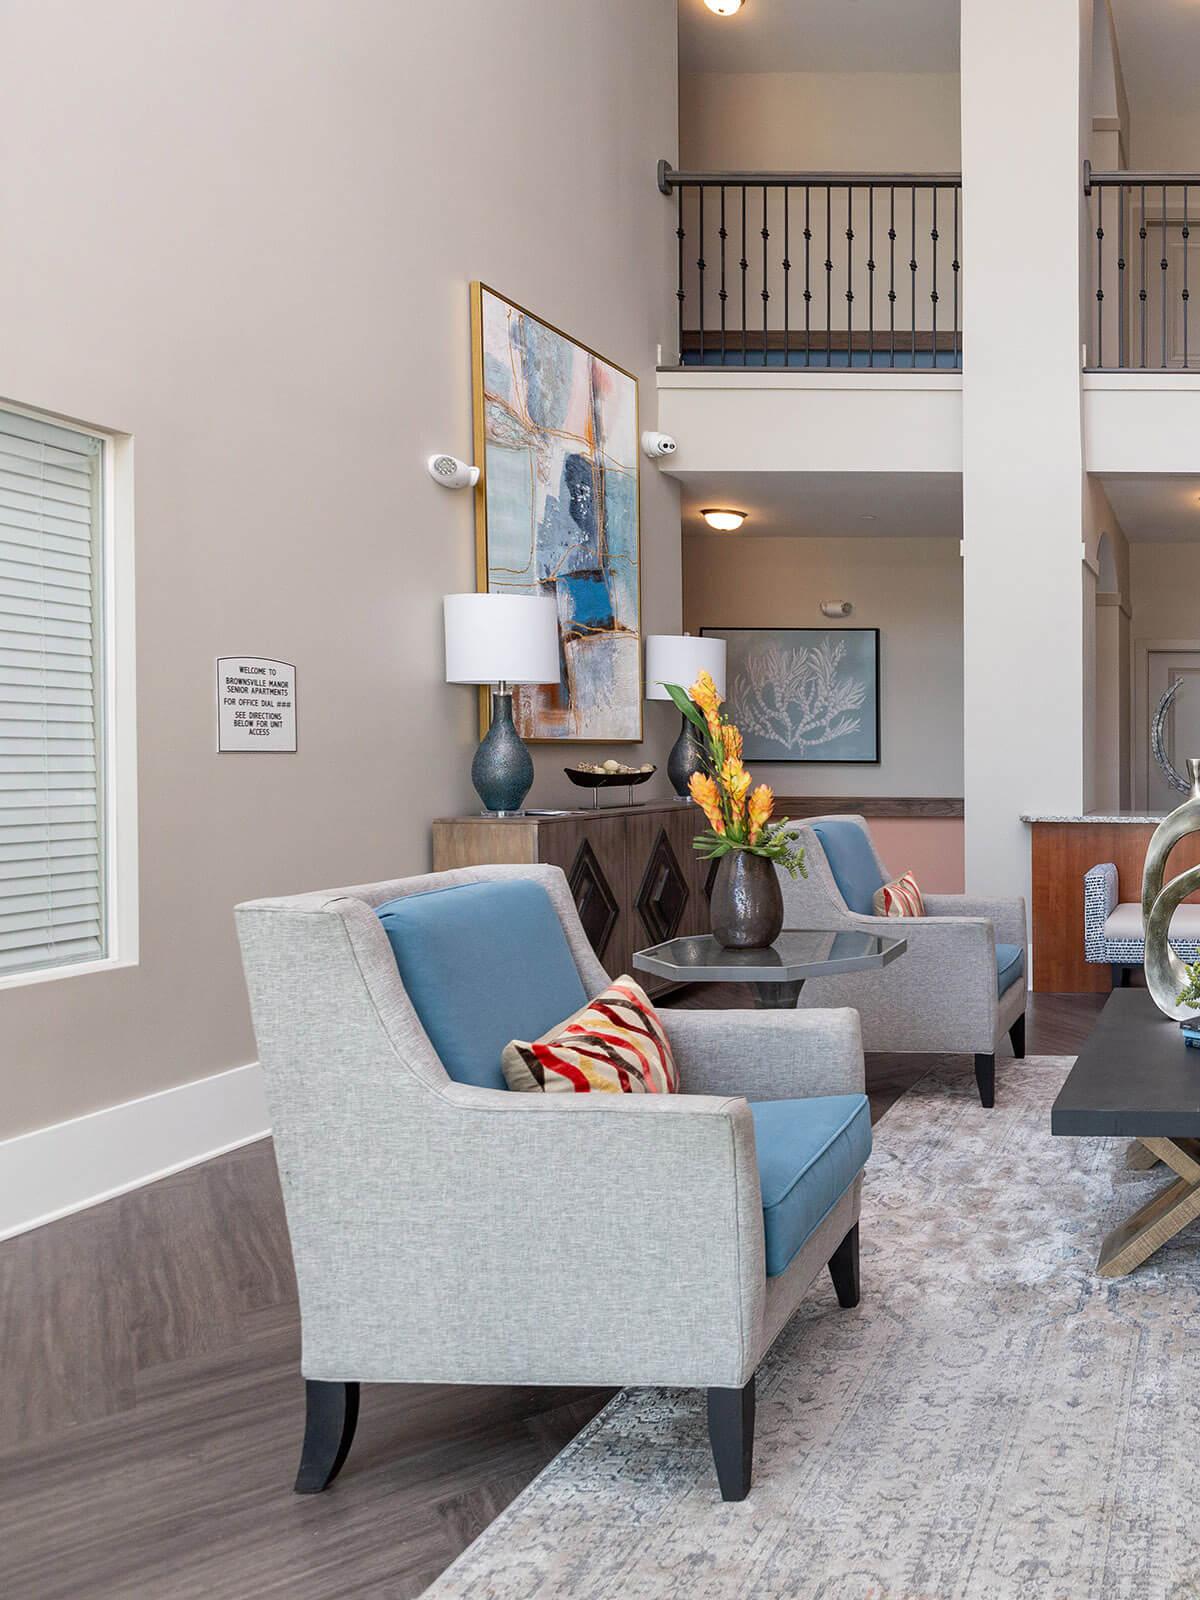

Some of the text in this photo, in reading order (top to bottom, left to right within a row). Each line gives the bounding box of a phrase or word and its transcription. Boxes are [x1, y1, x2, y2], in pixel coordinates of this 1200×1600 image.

[239, 666, 276, 676] WELCOME TO
[225, 677, 288, 688] BROWNSVILLE MANOR
[227, 685, 288, 696] SENIOR APARTMENTS
[224, 697, 236, 705] FOR
[238, 698, 258, 706] OFFICE
[235, 711, 282, 720] SEE DIRECTIONS
[233, 719, 283, 728] BELOW FOR UNIT
[249, 728, 270, 736] ACCESS
